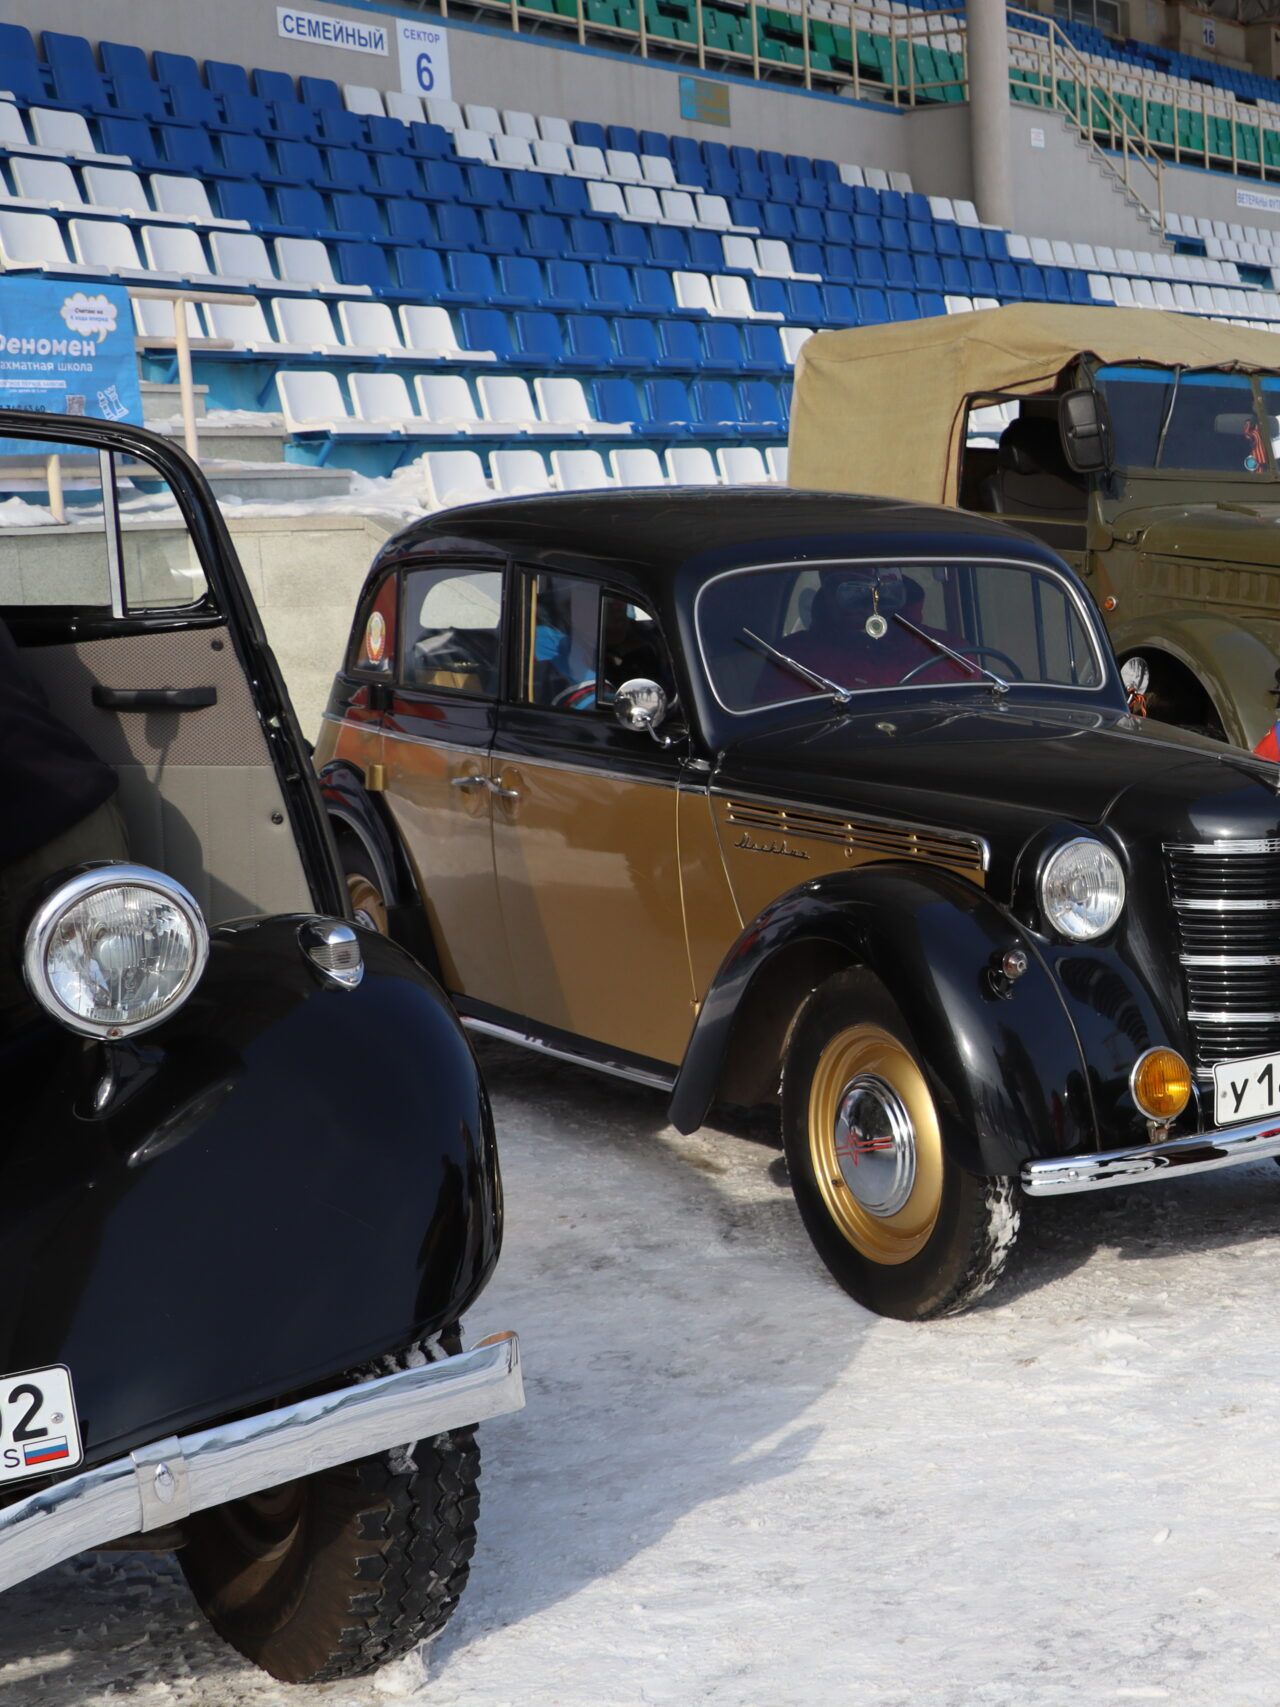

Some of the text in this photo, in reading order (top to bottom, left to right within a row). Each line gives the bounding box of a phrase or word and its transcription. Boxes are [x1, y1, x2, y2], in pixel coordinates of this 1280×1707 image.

[282, 14, 385, 51] СЕМЕЙНЫЙ
[403, 27, 441, 45] СЕКТОР
[1202, 29, 1215, 45] 16
[416, 52, 434, 92] 6
[0, 361, 93, 372] ахматная школа
[0, 1384, 49, 1443] 2
